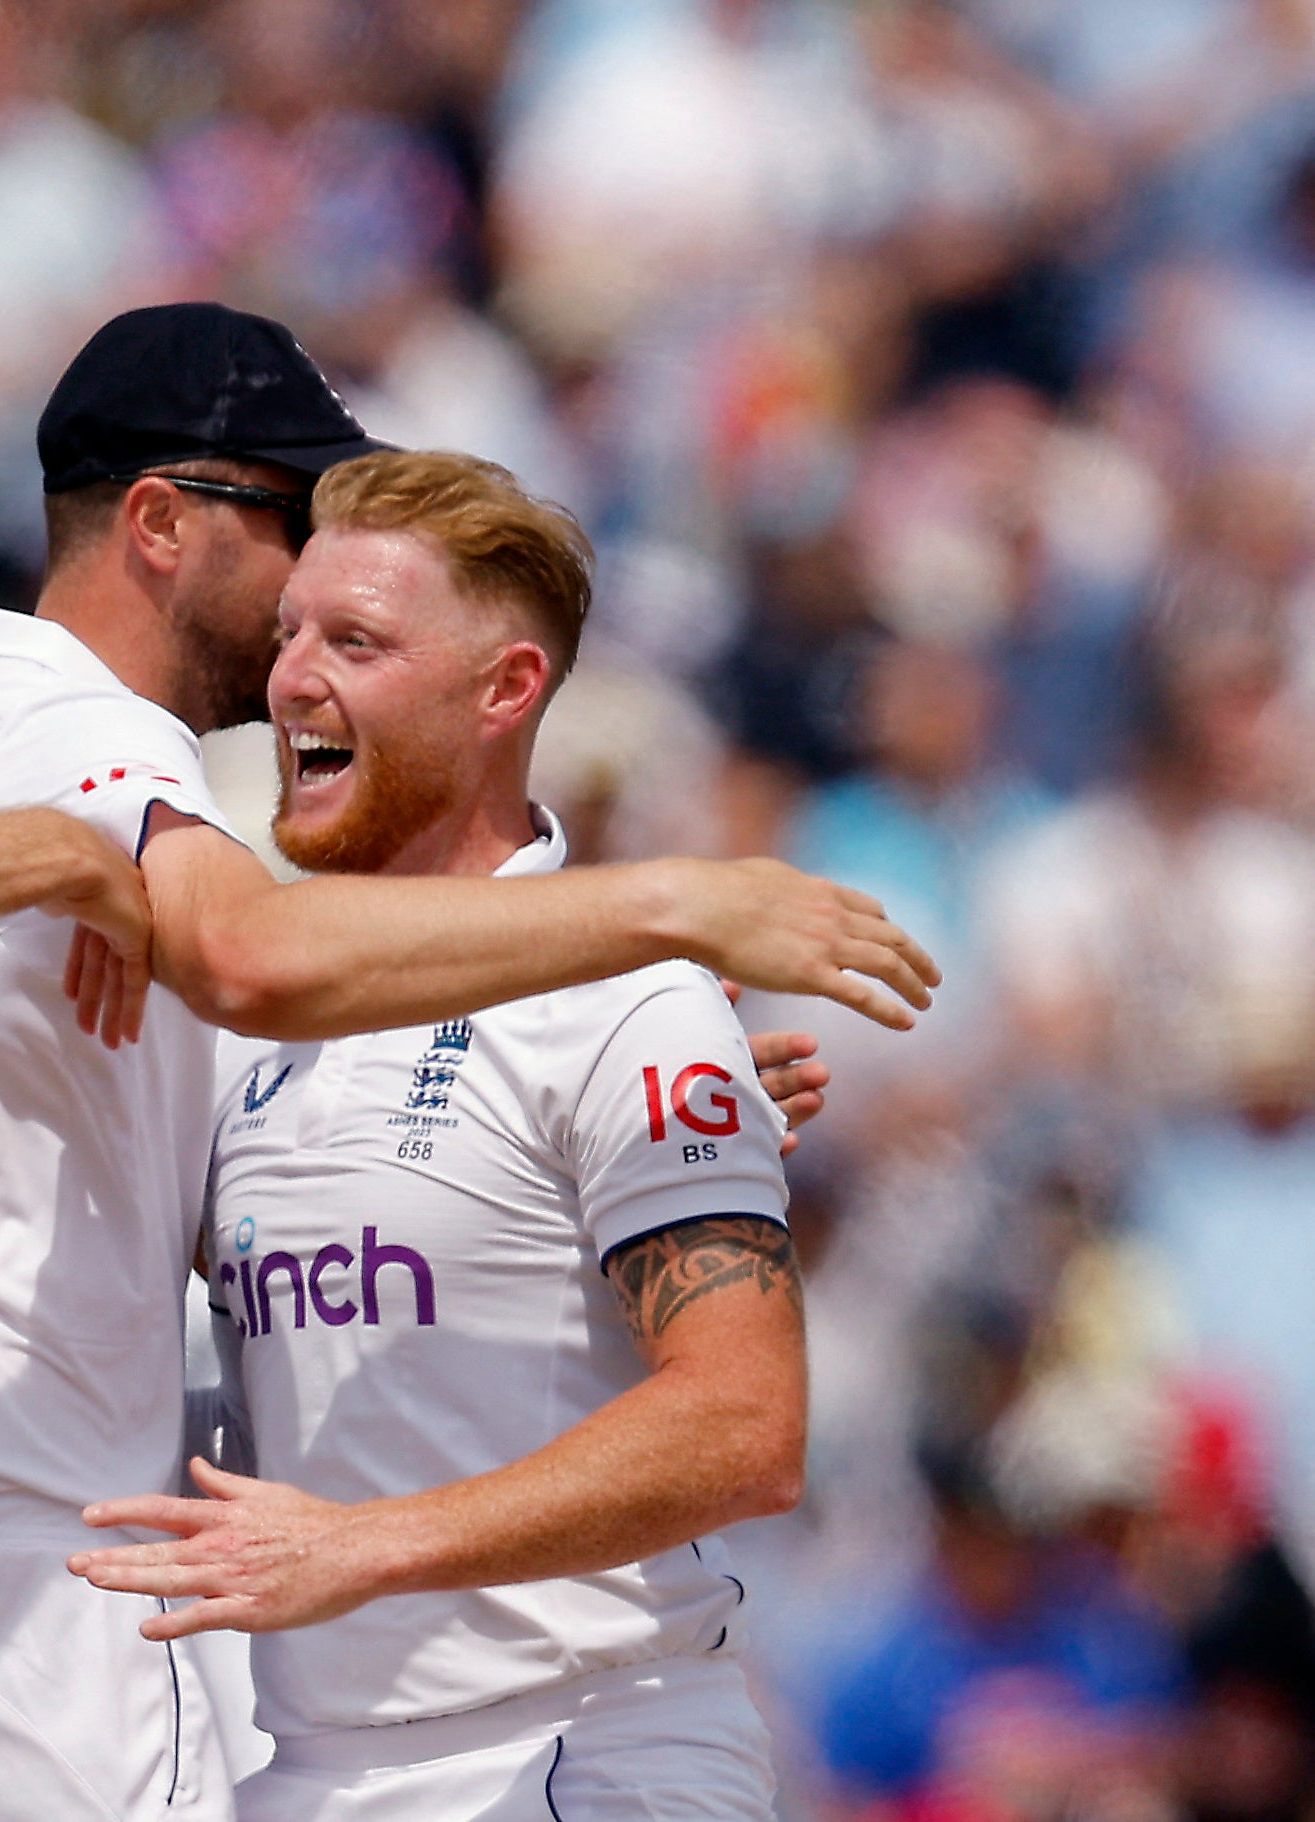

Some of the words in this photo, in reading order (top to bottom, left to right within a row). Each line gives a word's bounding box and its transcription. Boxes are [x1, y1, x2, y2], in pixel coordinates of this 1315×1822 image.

[642, 1062, 742, 1143] IG
[398, 1140, 434, 1161] 658
[682, 1143, 718, 1164] BS
